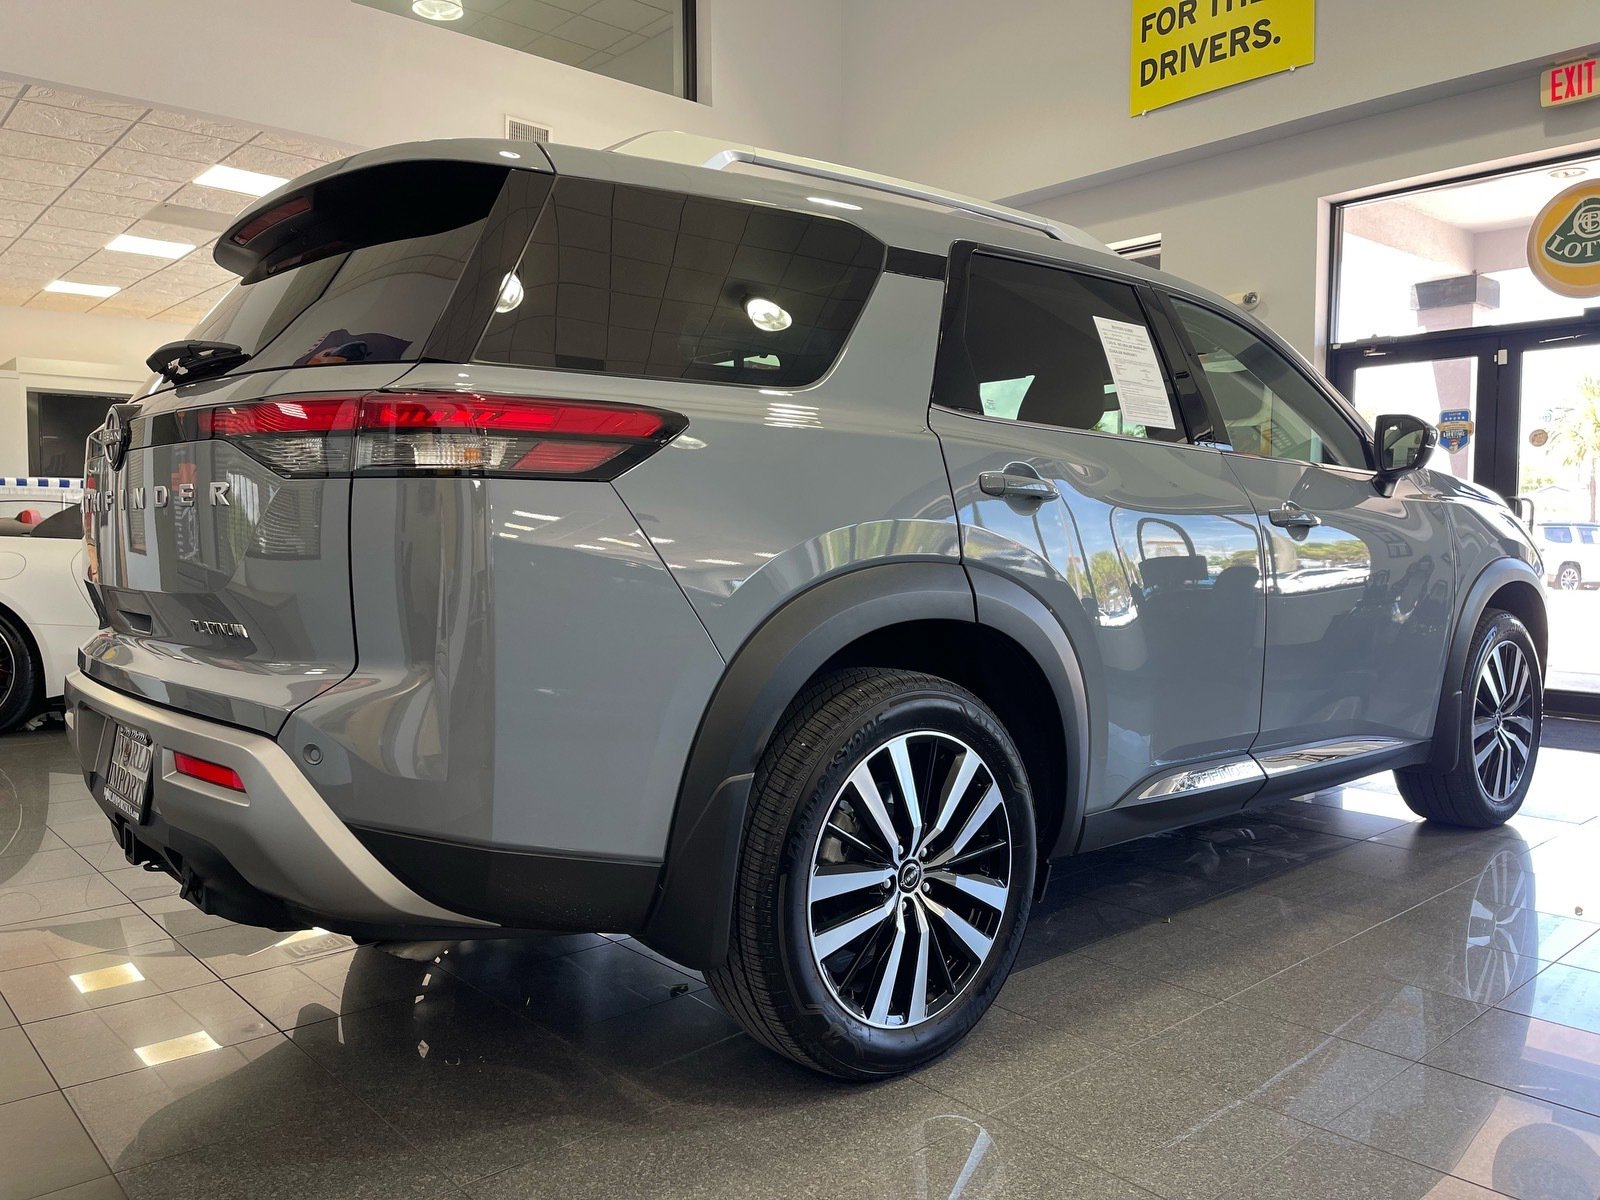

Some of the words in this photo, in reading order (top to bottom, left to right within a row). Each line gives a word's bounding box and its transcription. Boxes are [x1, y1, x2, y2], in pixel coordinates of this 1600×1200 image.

[1141, 0, 1197, 43] FOR
[1140, 18, 1281, 87] DRIVERS.
[1551, 60, 1597, 102] EXIT
[1547, 234, 1600, 258] LOT
